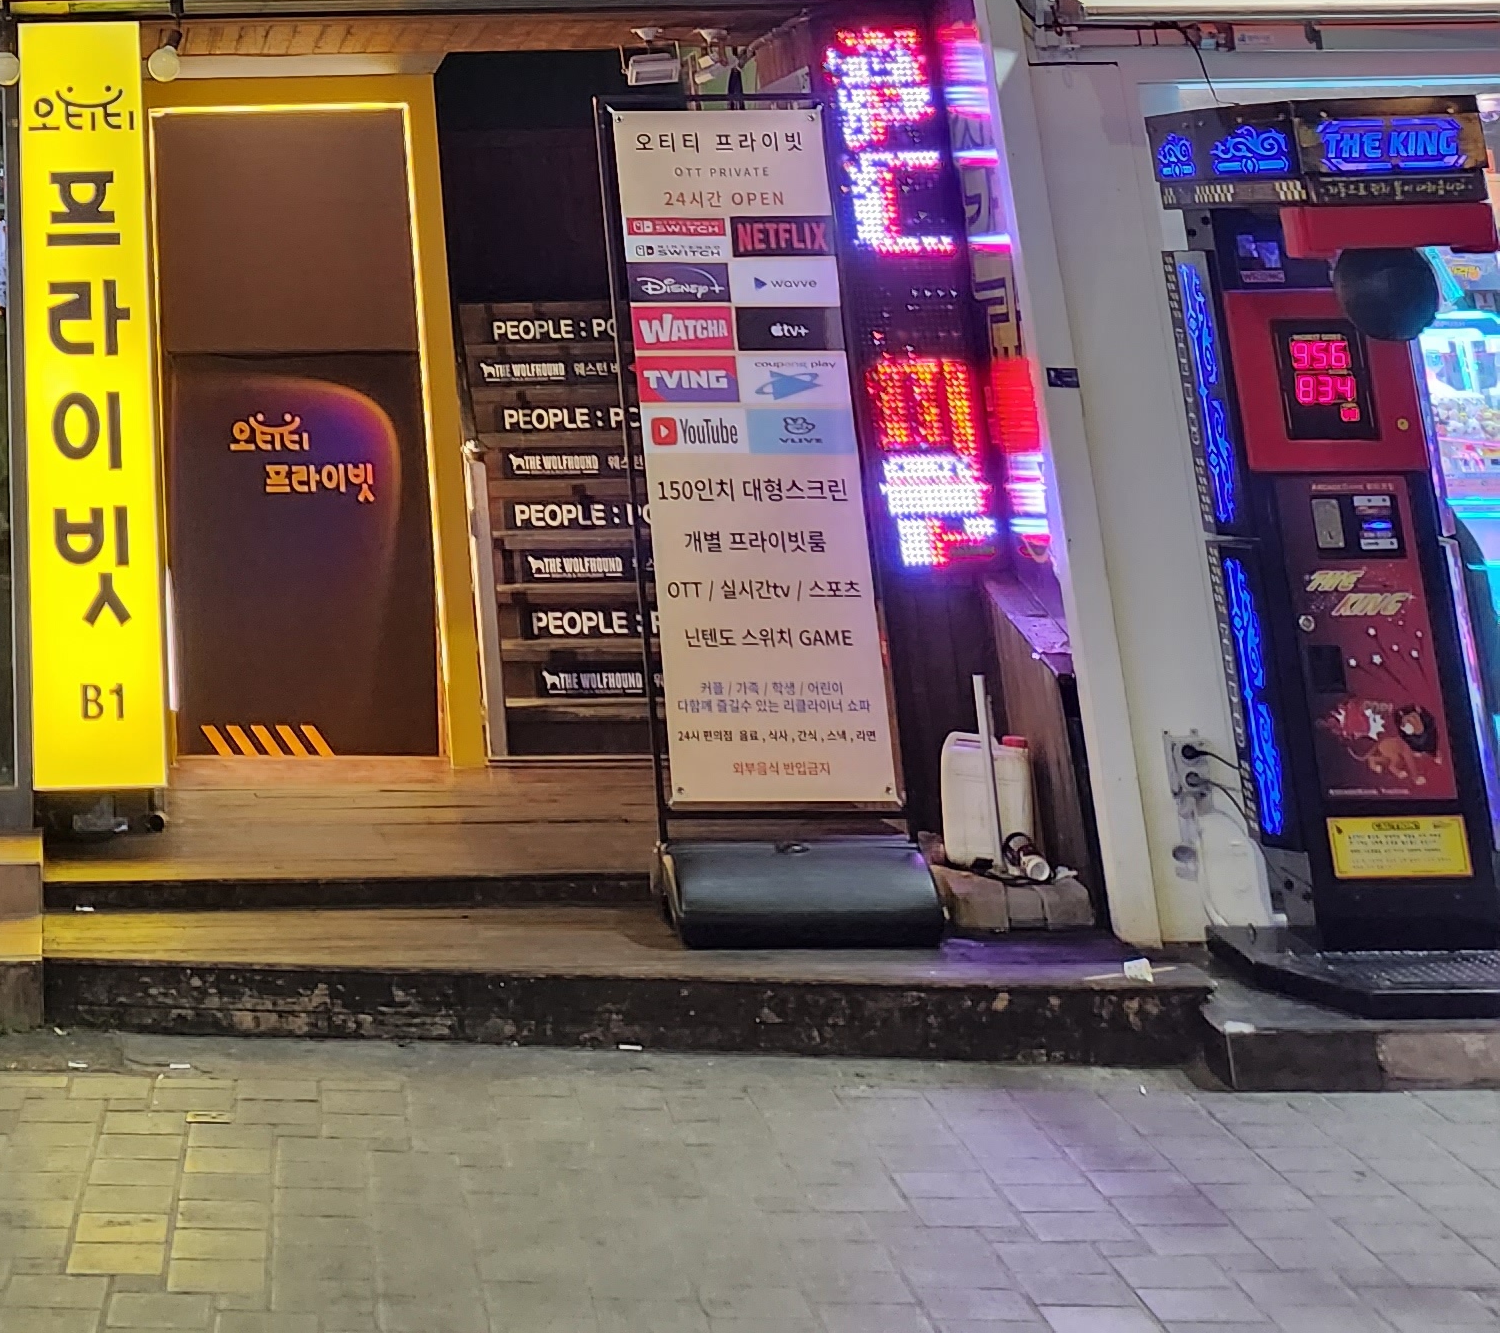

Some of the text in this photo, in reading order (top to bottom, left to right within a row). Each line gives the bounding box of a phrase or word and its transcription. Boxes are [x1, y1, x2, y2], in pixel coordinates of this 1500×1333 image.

[635, 131, 803, 154] 오티티 프라이빗
[1324, 129, 1458, 159] THE KING
[674, 165, 770, 177] OTT PRIVATE
[663, 191, 785, 209] 24시간 OPEN
[655, 224, 720, 234] SWITCH
[736, 221, 830, 253] NETFLIX
[657, 249, 722, 257] SWITCH
[770, 278, 818, 289] wavve
[492, 318, 575, 340] PEOPLE
[638, 313, 729, 345] WATCHA
[810, 359, 837, 370] play
[1291, 341, 1349, 370] 956
[643, 369, 730, 389] TVING
[1296, 374, 1357, 405] 834
[45, 169, 134, 630] 프라이빗
[504, 407, 591, 430] PEOPLE
[679, 417, 740, 445] YouTube
[524, 454, 542, 471] THE
[543, 453, 600, 470] WOLFHOUND
[264, 461, 377, 504] 프라이빗
[657, 477, 849, 502] 150인치 대형스크린
[514, 503, 606, 527] PEOPLE
[684, 530, 827, 553] 개별 프라이빗룸
[542, 556, 562, 573] THE
[562, 556, 624, 573] WOLFHOUND
[667, 579, 862, 600] OTT 실시간tv 스포츠
[532, 611, 630, 636] PEOPLE
[684, 627, 854, 649] 닌텐도 스위치 GAME
[559, 671, 579, 689] THE
[579, 670, 644, 689] WOLFHOUND
[807, 681, 844, 696] 어린이
[80, 681, 127, 722] B1
[783, 761, 831, 776] 반입금지
